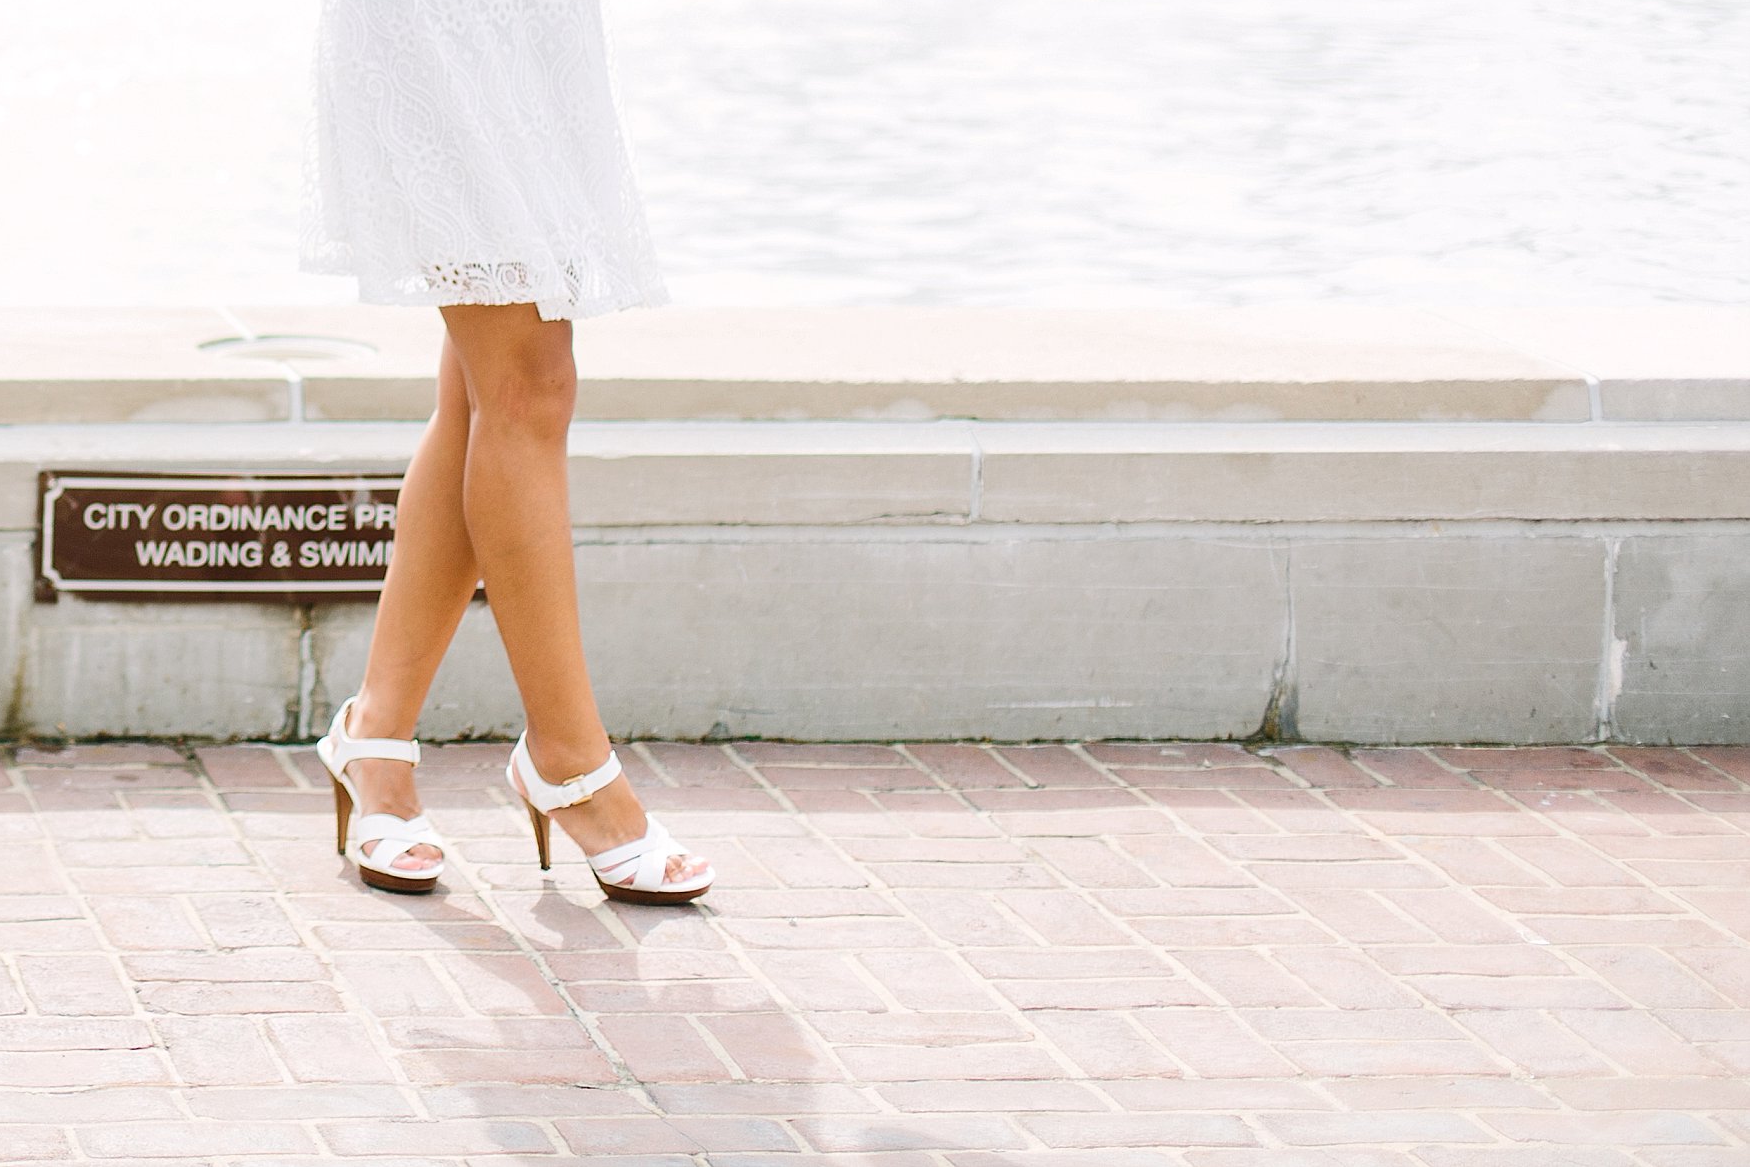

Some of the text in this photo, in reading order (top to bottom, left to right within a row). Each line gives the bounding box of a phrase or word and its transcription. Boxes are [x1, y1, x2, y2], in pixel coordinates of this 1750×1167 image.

[83, 503, 156, 530] CITY
[162, 504, 347, 531] ORDINANCE
[135, 541, 262, 567] WADING
[270, 541, 292, 567] &
